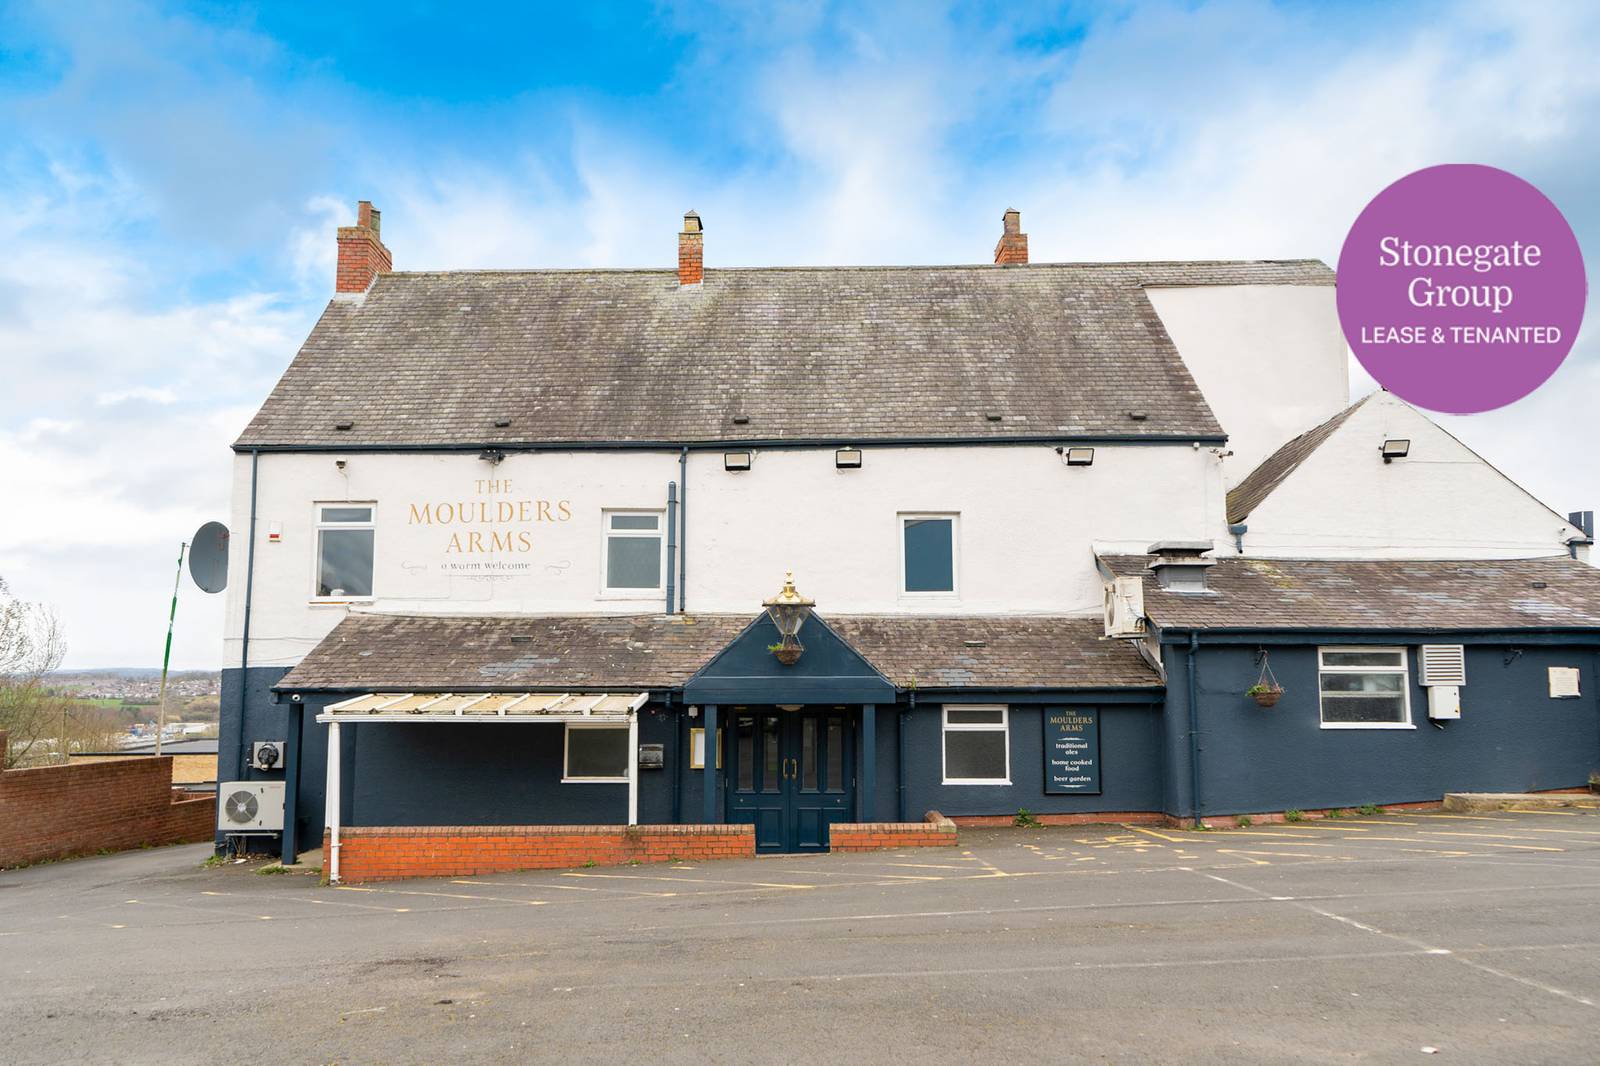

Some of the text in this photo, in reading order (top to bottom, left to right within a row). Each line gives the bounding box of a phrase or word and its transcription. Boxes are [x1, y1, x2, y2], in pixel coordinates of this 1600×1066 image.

[475, 479, 512, 494] THE
[408, 500, 572, 525] MOULDERS
[446, 531, 532, 553] ARMS
[450, 562, 481, 570] warm
[484, 560, 531, 570] welcome
